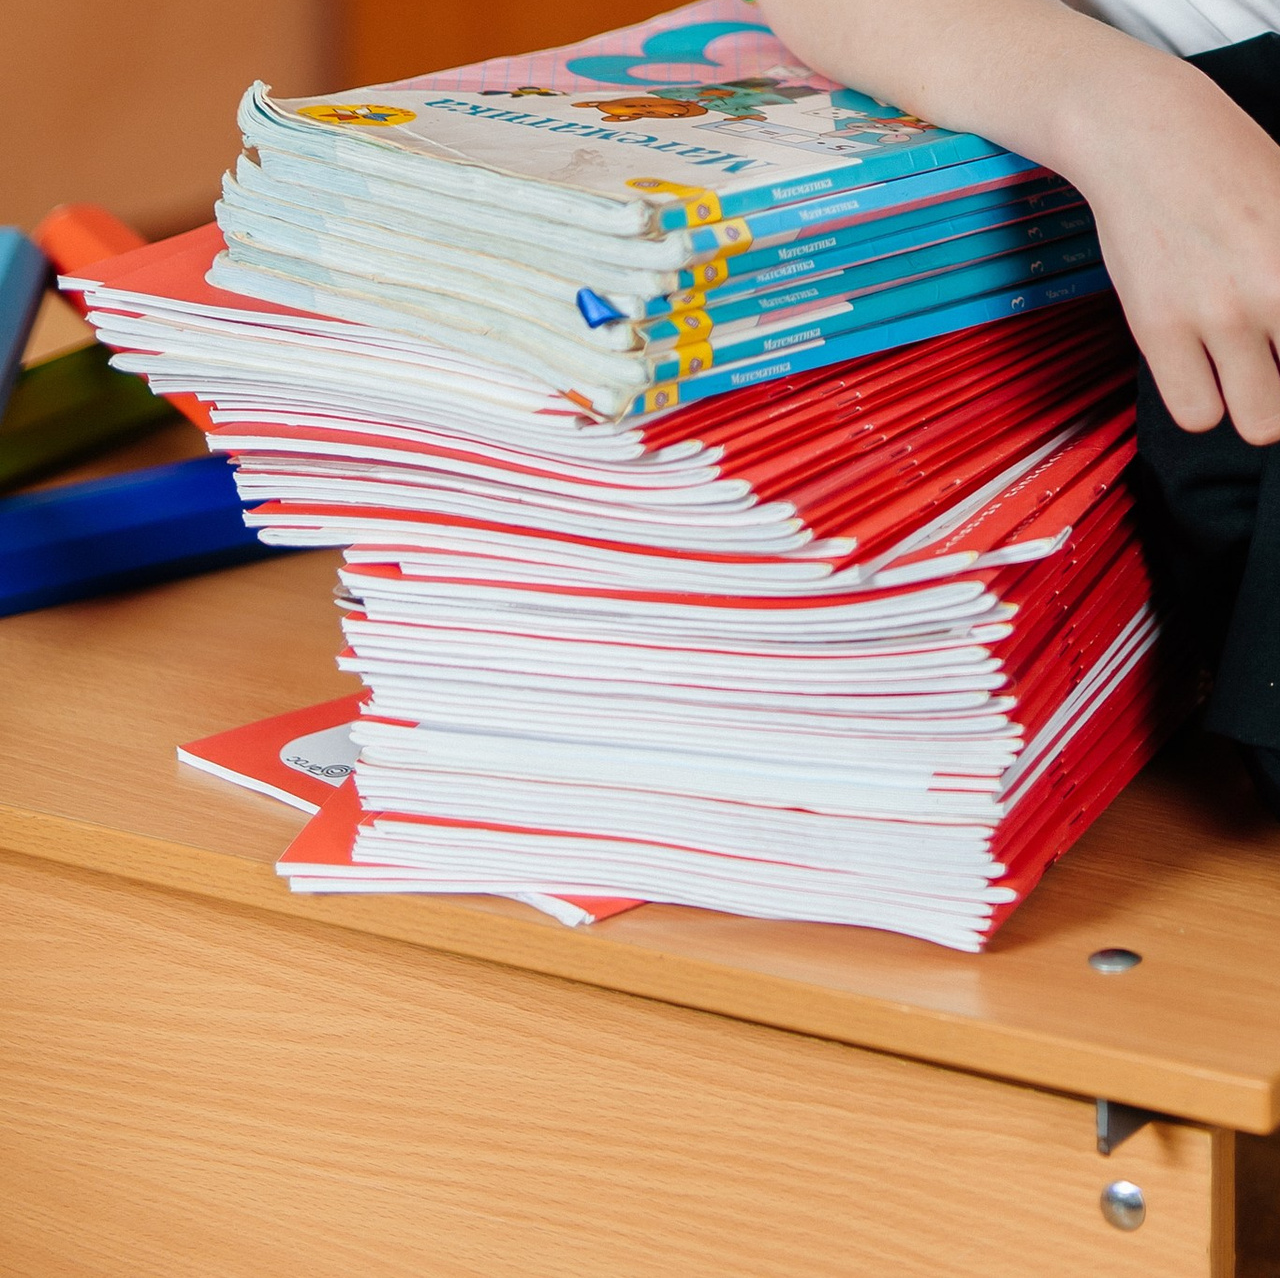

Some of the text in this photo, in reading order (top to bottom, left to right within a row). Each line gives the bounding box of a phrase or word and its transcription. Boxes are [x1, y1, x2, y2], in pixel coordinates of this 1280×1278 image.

[424, 98, 779, 173] Математика
[772, 178, 833, 201] Математика
[799, 199, 859, 221] Математика
[778, 236, 837, 261] Математика
[758, 287, 819, 309] Математика
[763, 327, 821, 351] Математика
[731, 361, 791, 385] Математика
